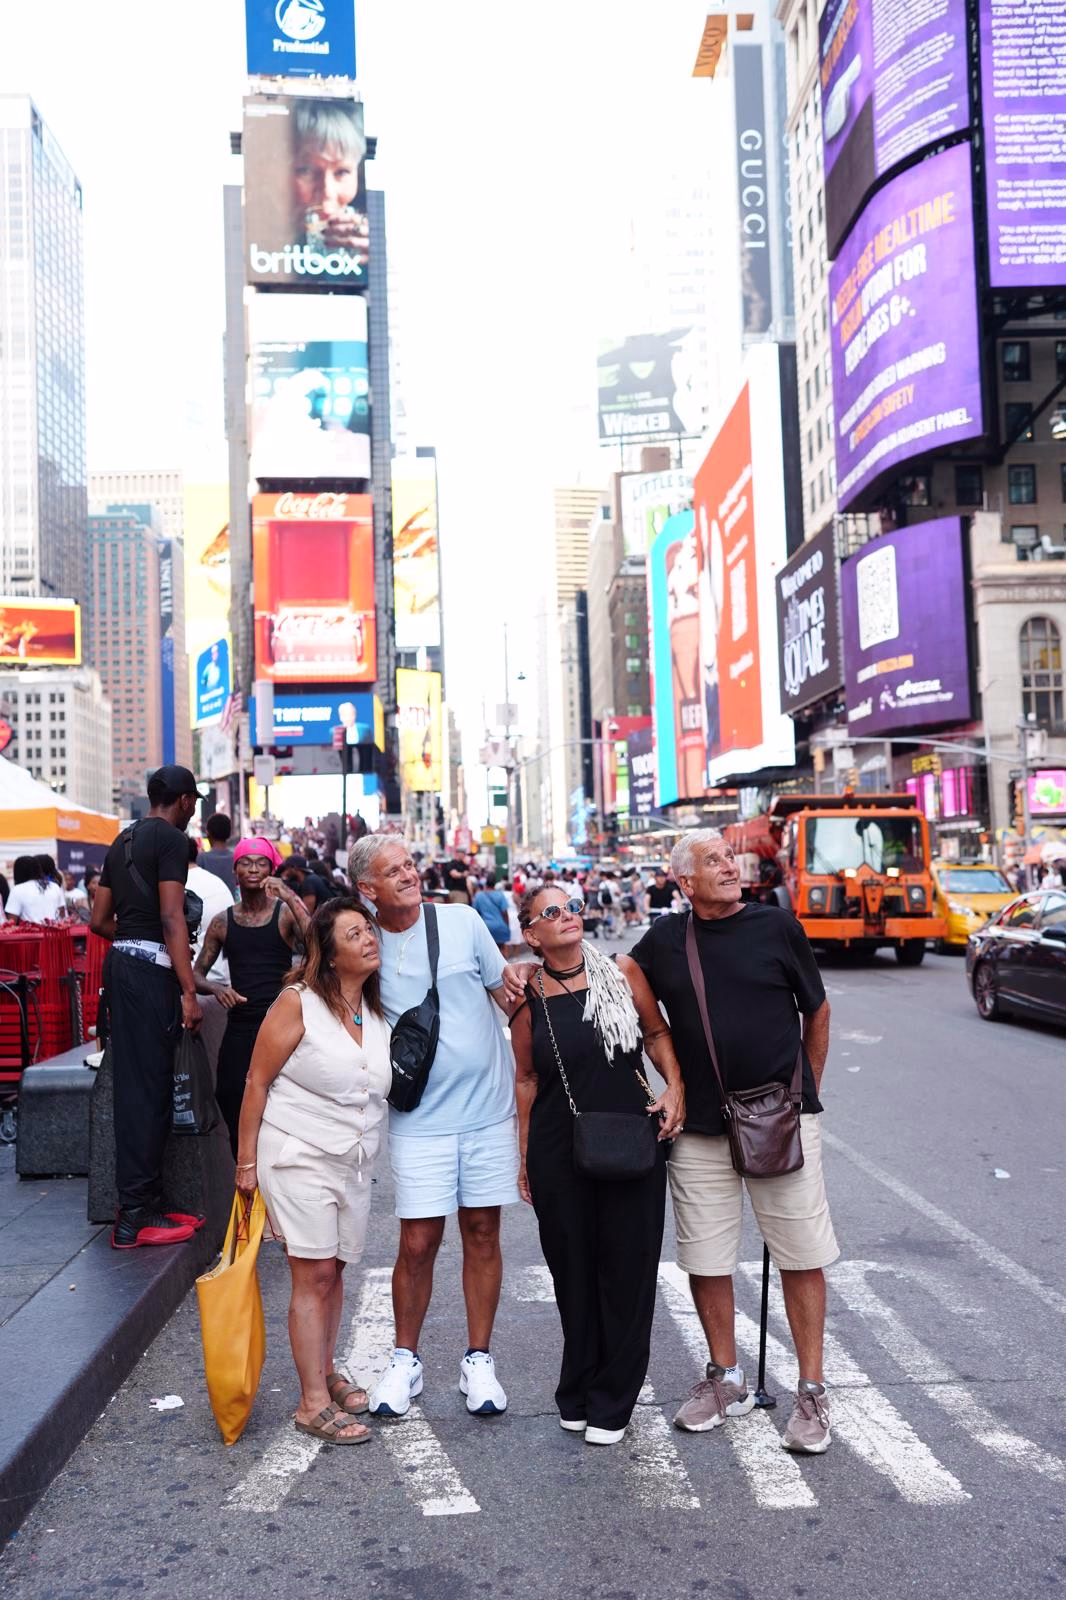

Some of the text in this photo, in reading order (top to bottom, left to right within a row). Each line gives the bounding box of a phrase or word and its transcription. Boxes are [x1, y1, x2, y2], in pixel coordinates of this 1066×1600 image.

[273, 39, 329, 54] Prudential
[740, 129, 766, 248] GUCCI
[874, 192, 956, 263] MEALTIME
[250, 243, 362, 276] britbox
[894, 243, 927, 287] FOR
